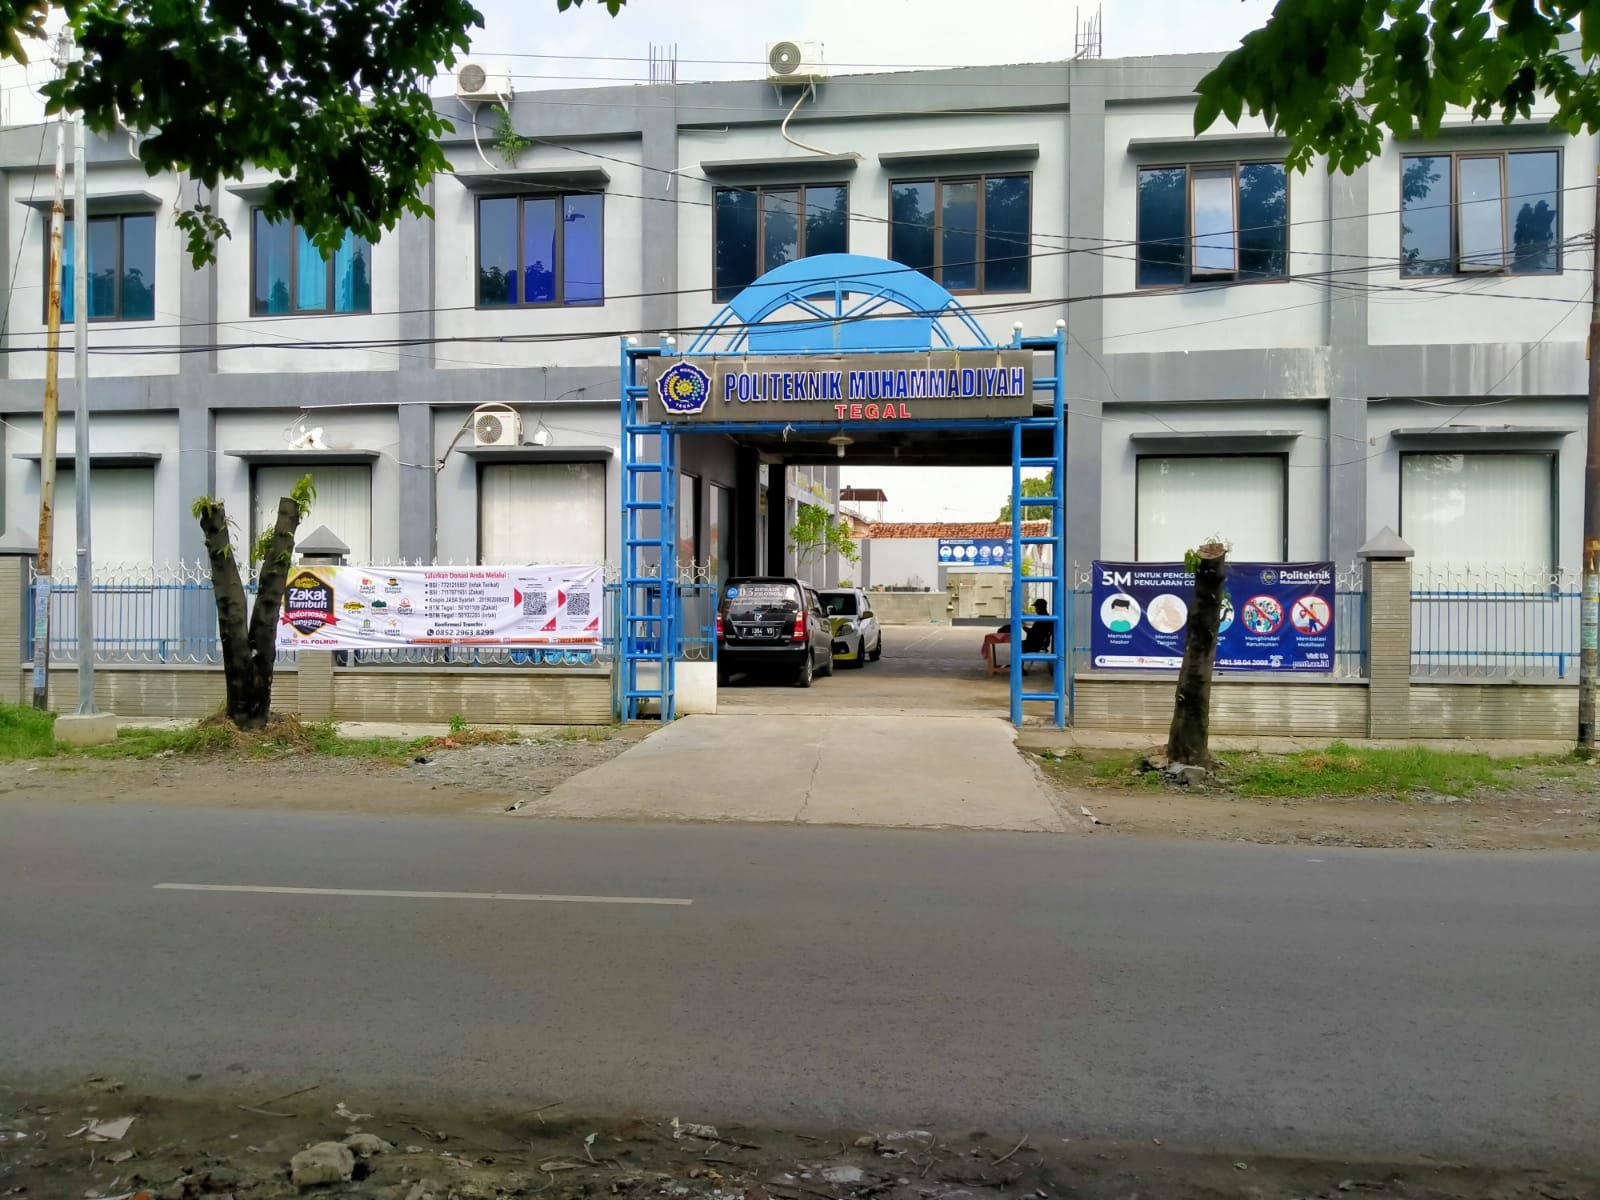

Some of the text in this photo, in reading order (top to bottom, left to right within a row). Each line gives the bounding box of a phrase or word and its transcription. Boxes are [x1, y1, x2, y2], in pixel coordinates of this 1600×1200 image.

[724, 366, 1025, 402] POLITEKNIK MUHAMMADIYAH
[834, 403, 912, 419] TEGAL
[1101, 571, 1131, 586] 5M
[1280, 570, 1330, 580] Politeknik
[288, 588, 328, 601] Zakat
[288, 600, 328, 609] Tumbuh
